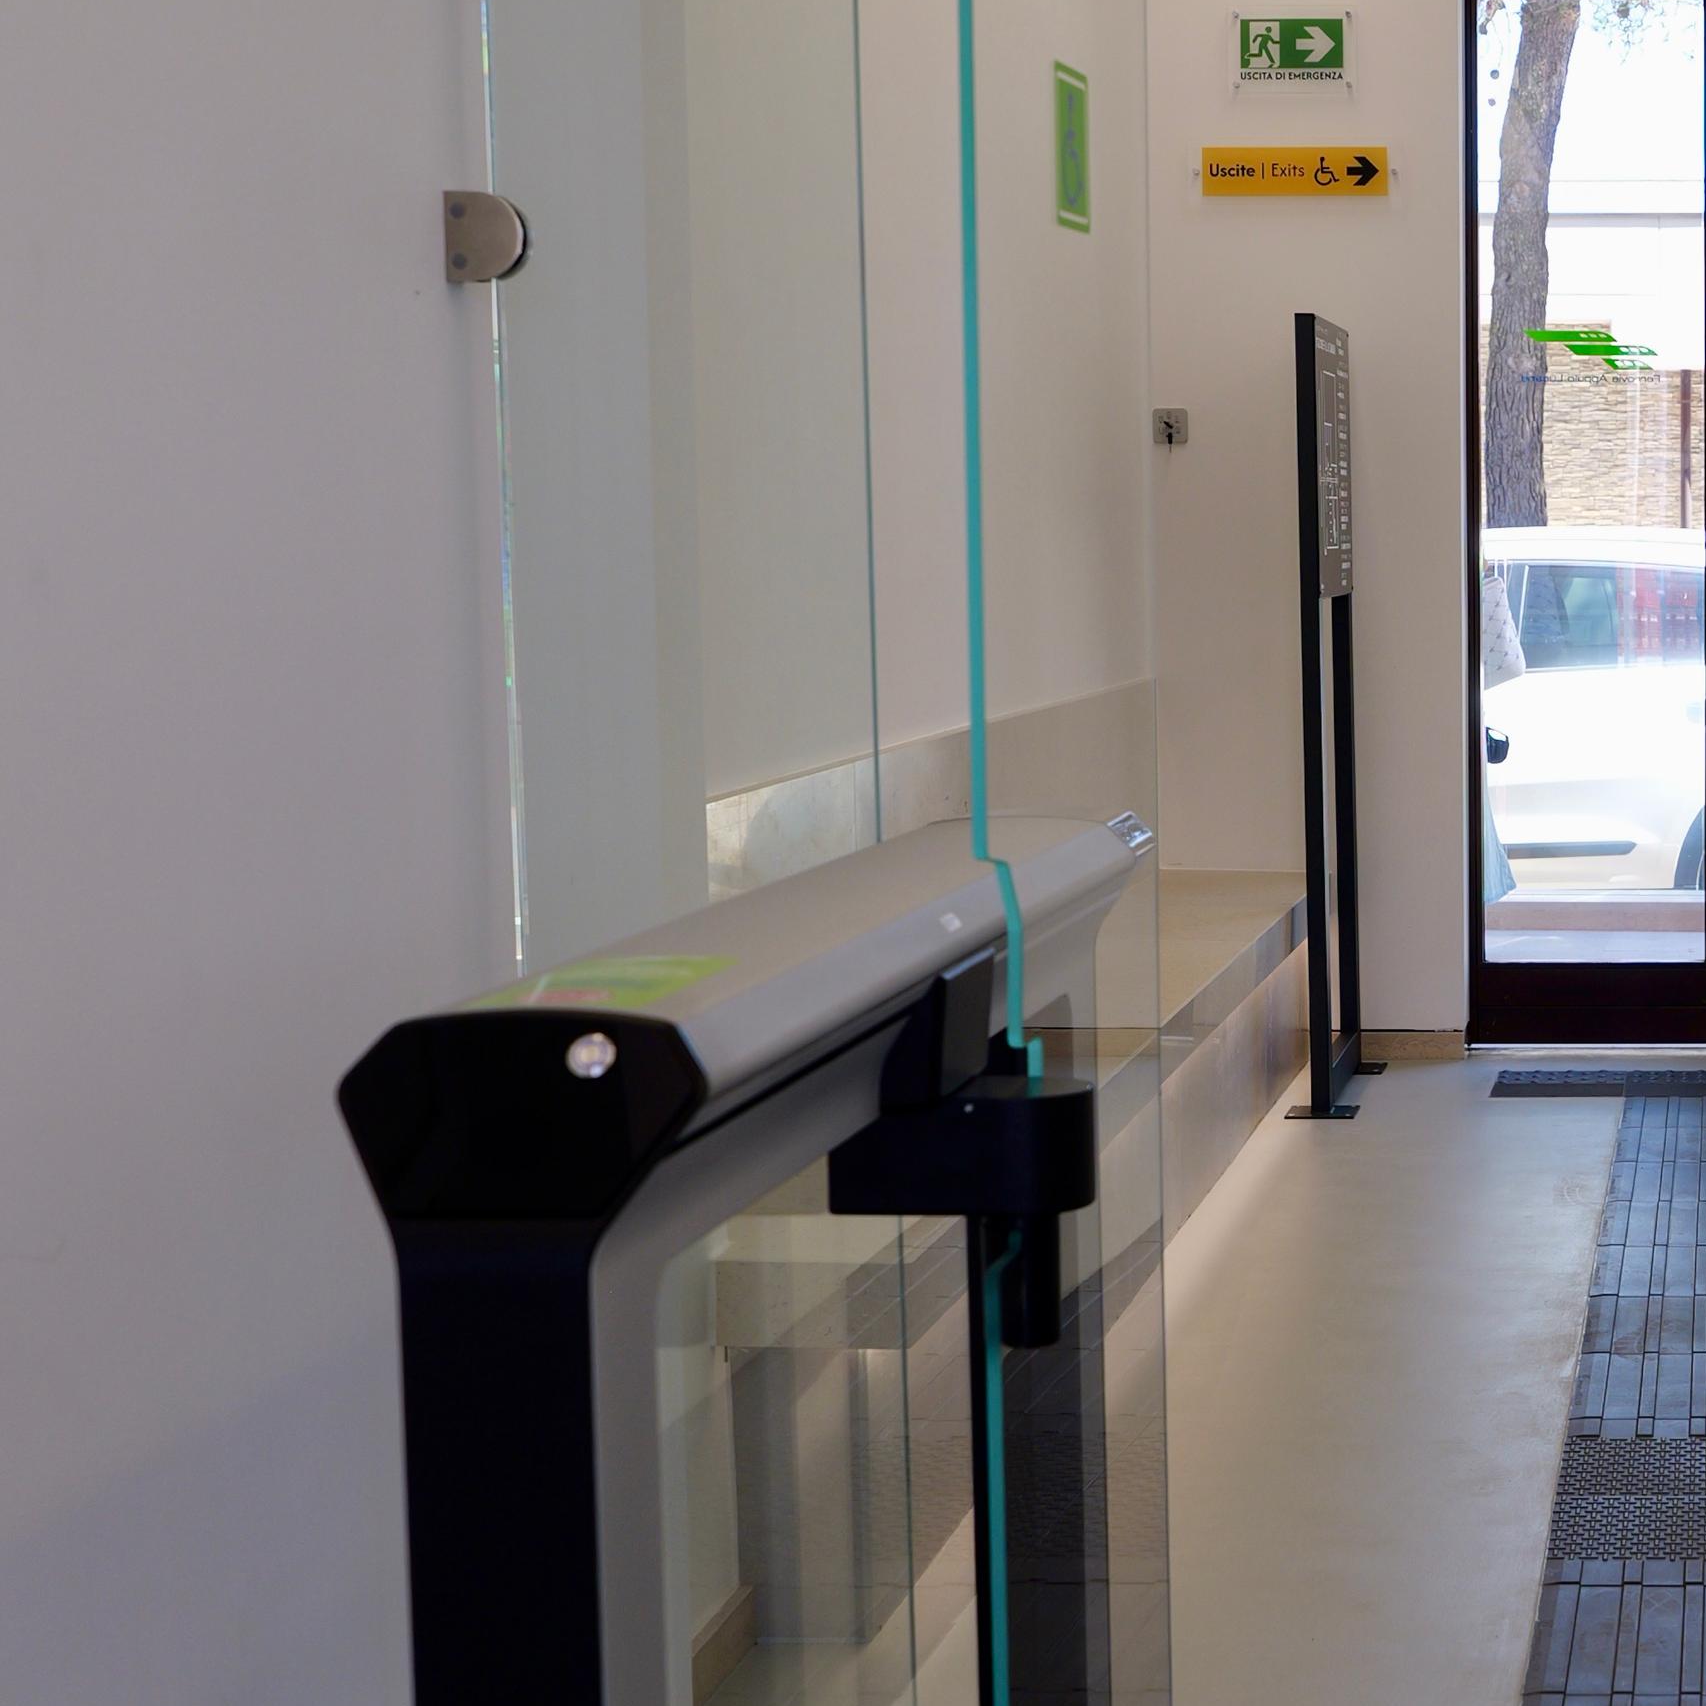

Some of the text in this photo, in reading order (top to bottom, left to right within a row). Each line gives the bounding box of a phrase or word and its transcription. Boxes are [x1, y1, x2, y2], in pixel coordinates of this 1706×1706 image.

[1240, 71, 1343, 80] USCITA DI EMERGENZA
[1209, 162, 1305, 177] Uscite Exits
